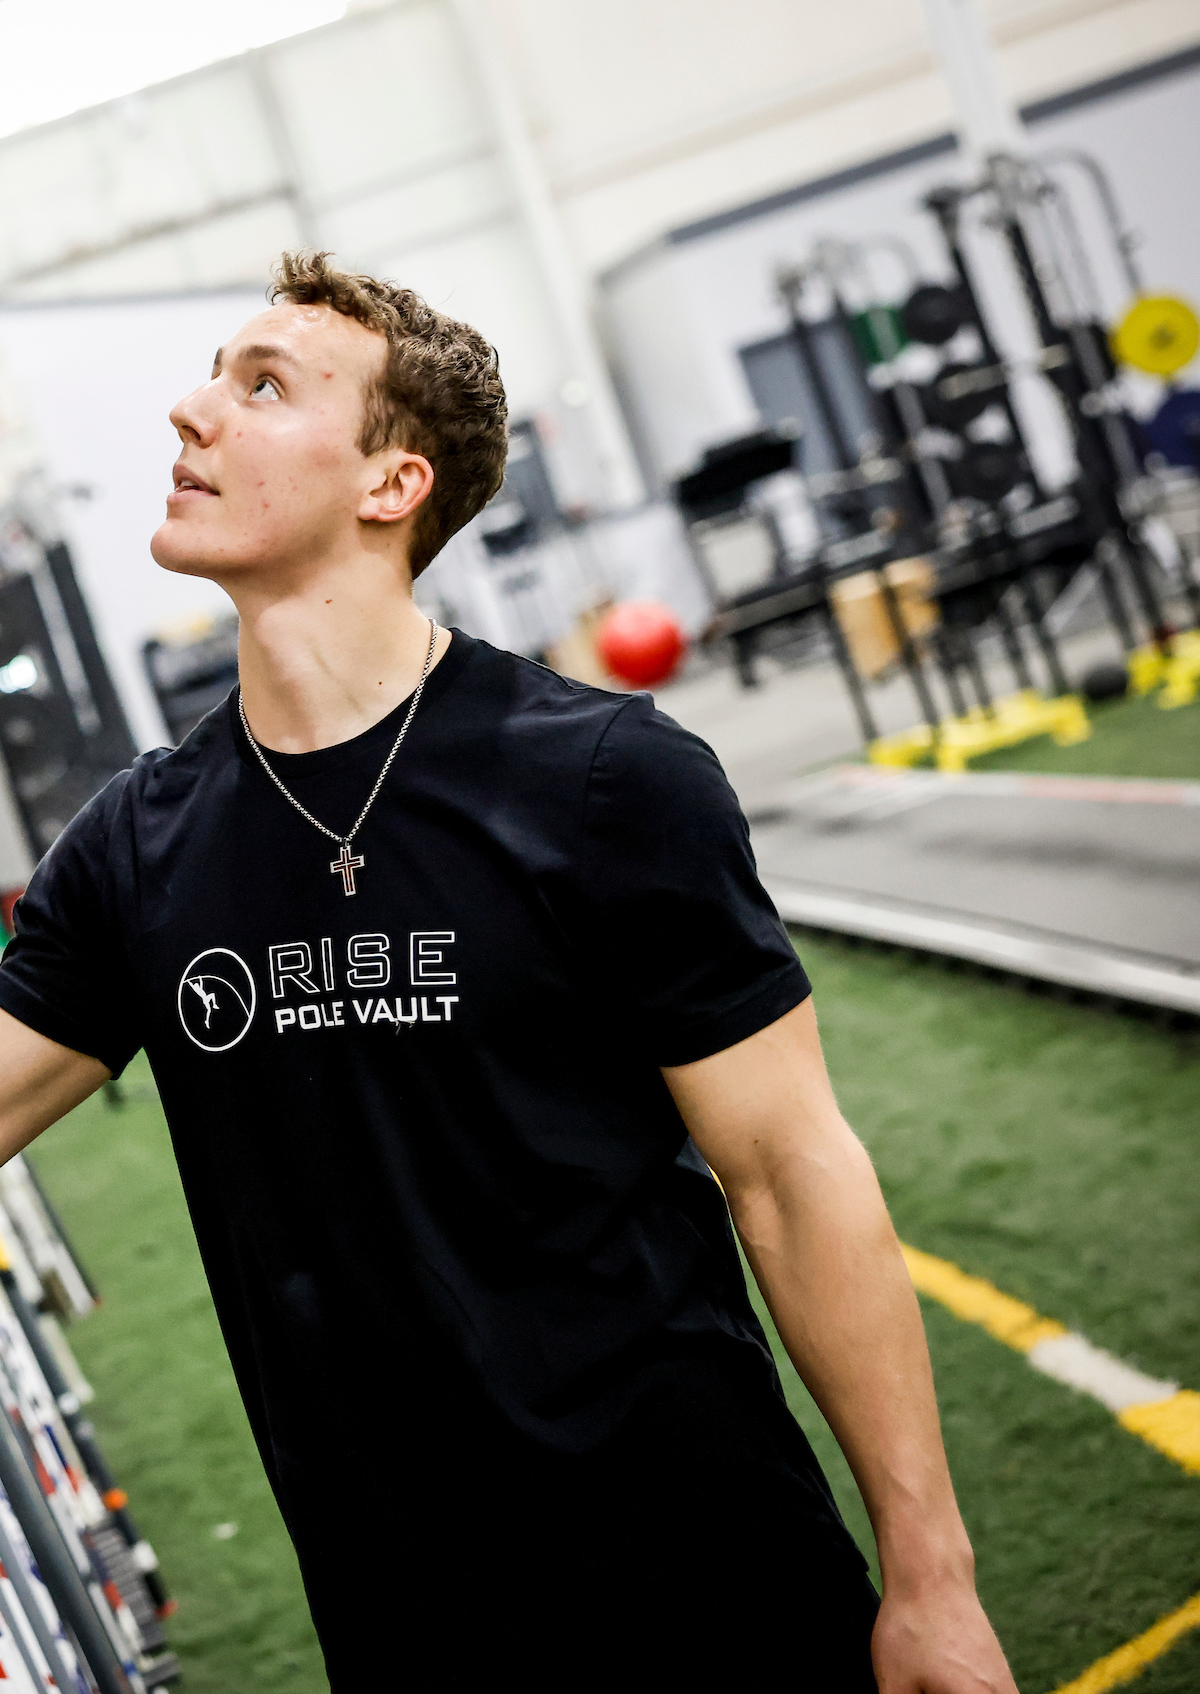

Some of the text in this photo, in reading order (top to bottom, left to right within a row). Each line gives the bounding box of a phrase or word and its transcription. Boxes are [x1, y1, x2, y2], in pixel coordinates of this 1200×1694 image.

[269, 931, 457, 998] RISE
[275, 996, 460, 1034] POLE VAULT
